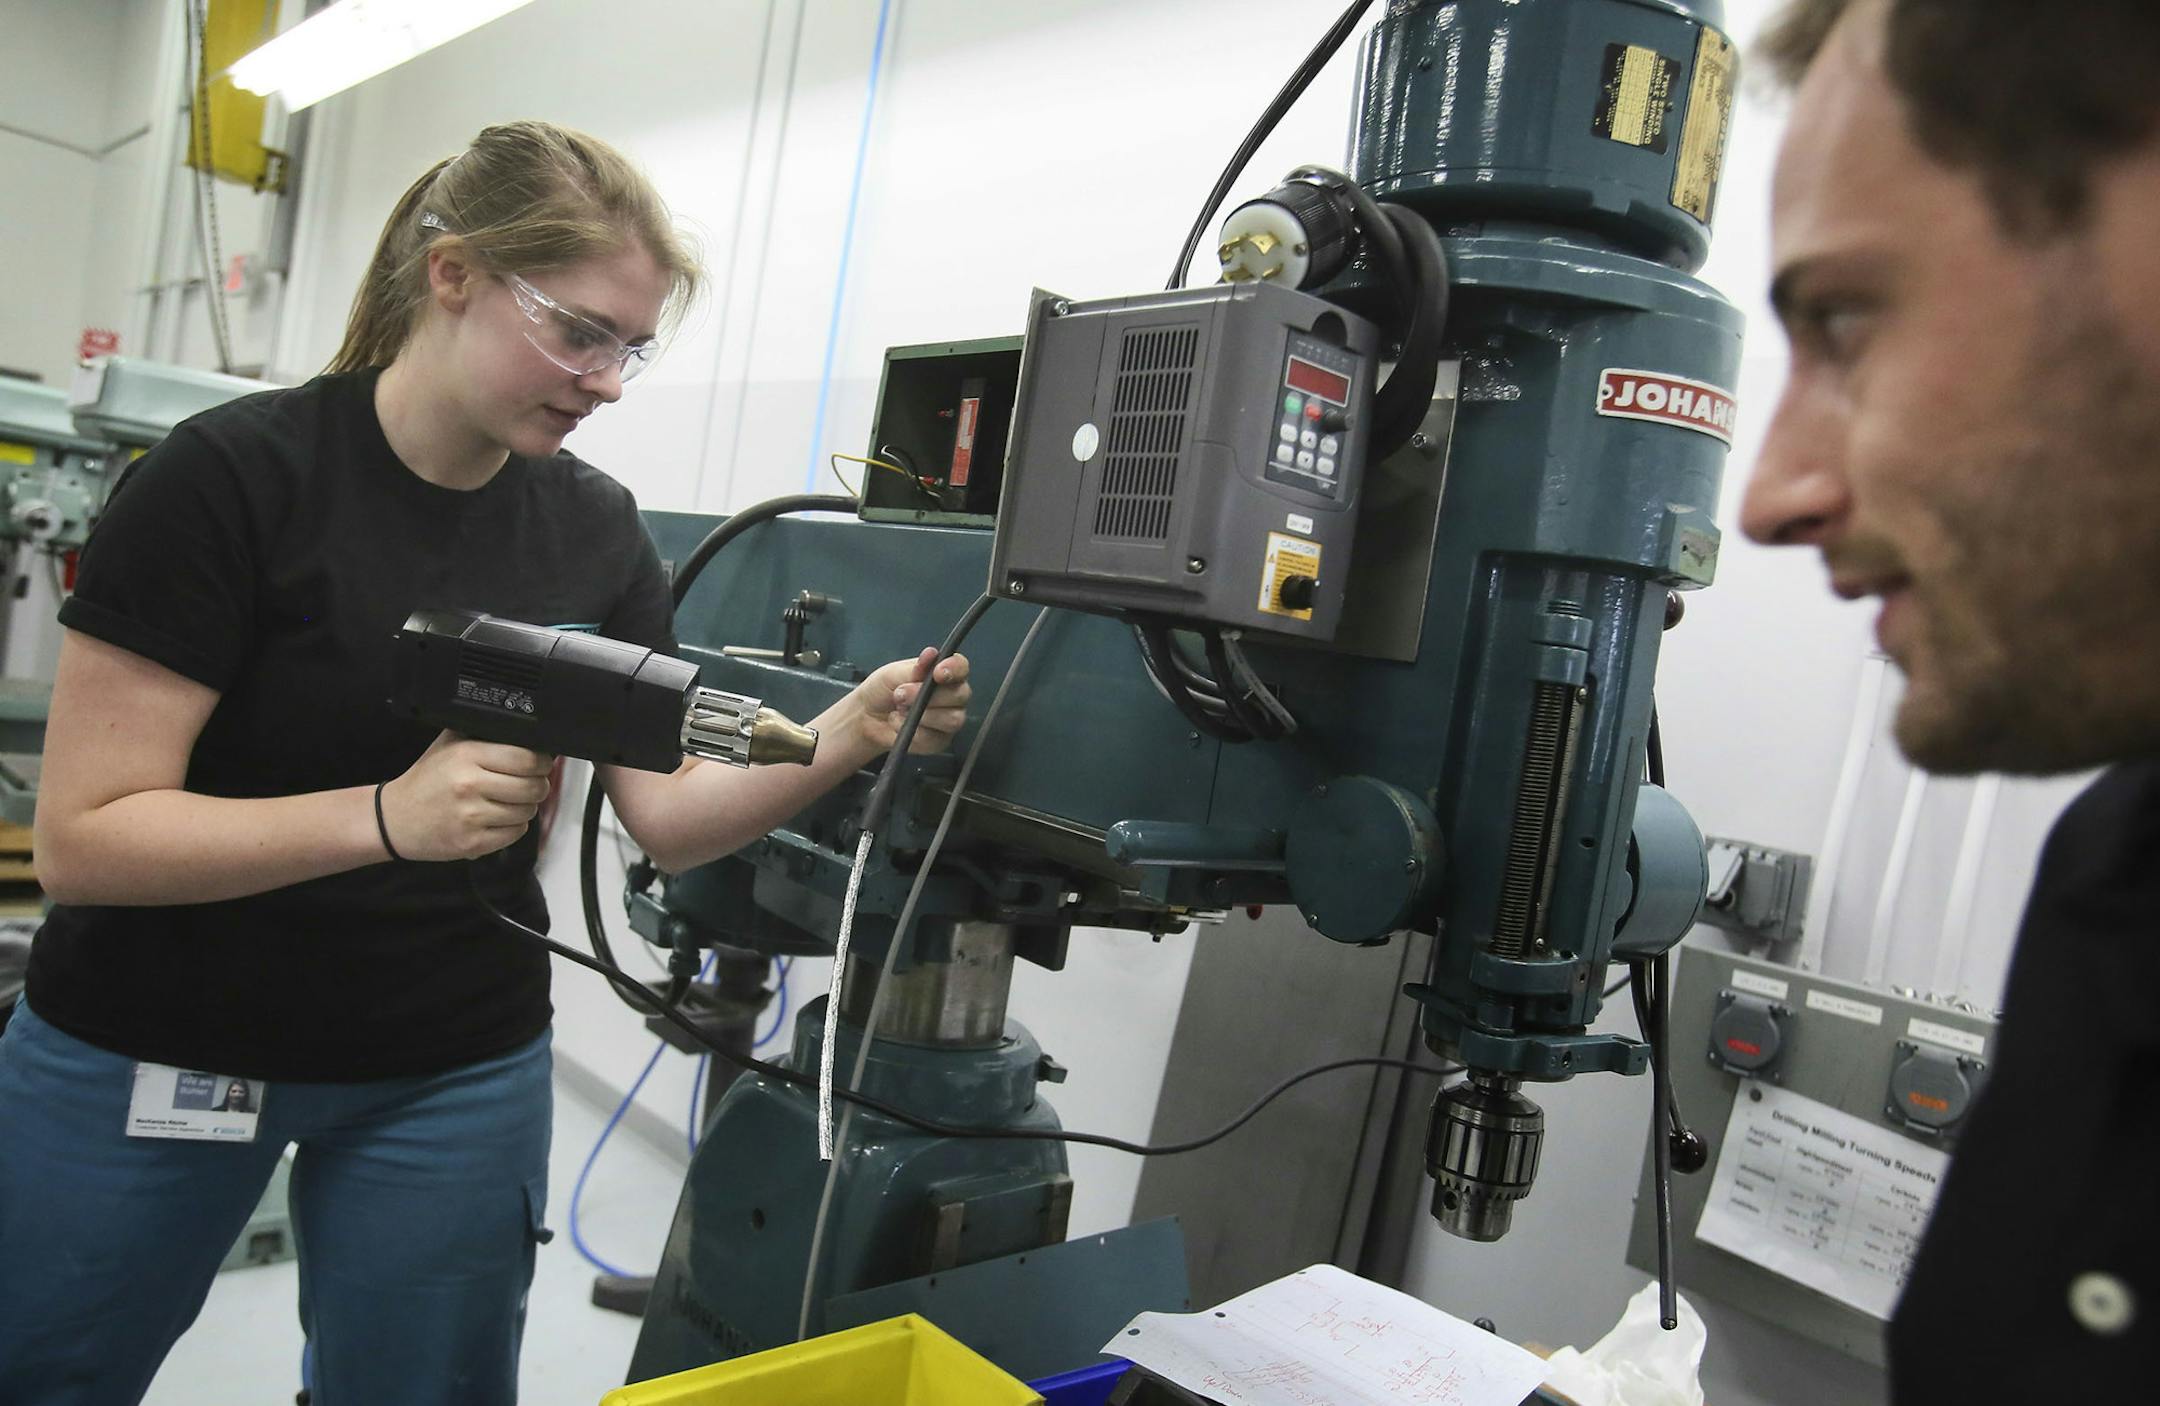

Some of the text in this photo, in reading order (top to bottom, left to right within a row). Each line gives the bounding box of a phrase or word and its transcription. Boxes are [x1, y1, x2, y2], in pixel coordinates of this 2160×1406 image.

[1652, 60, 1666, 97] SINGLE
[1643, 100, 1658, 145] WINDING
[1653, 73, 1671, 135] TWO SPEED
[1280, 540, 1316, 555] CAUTION
[1772, 1109, 1937, 1185] Drilling Milling Turning Speeds
